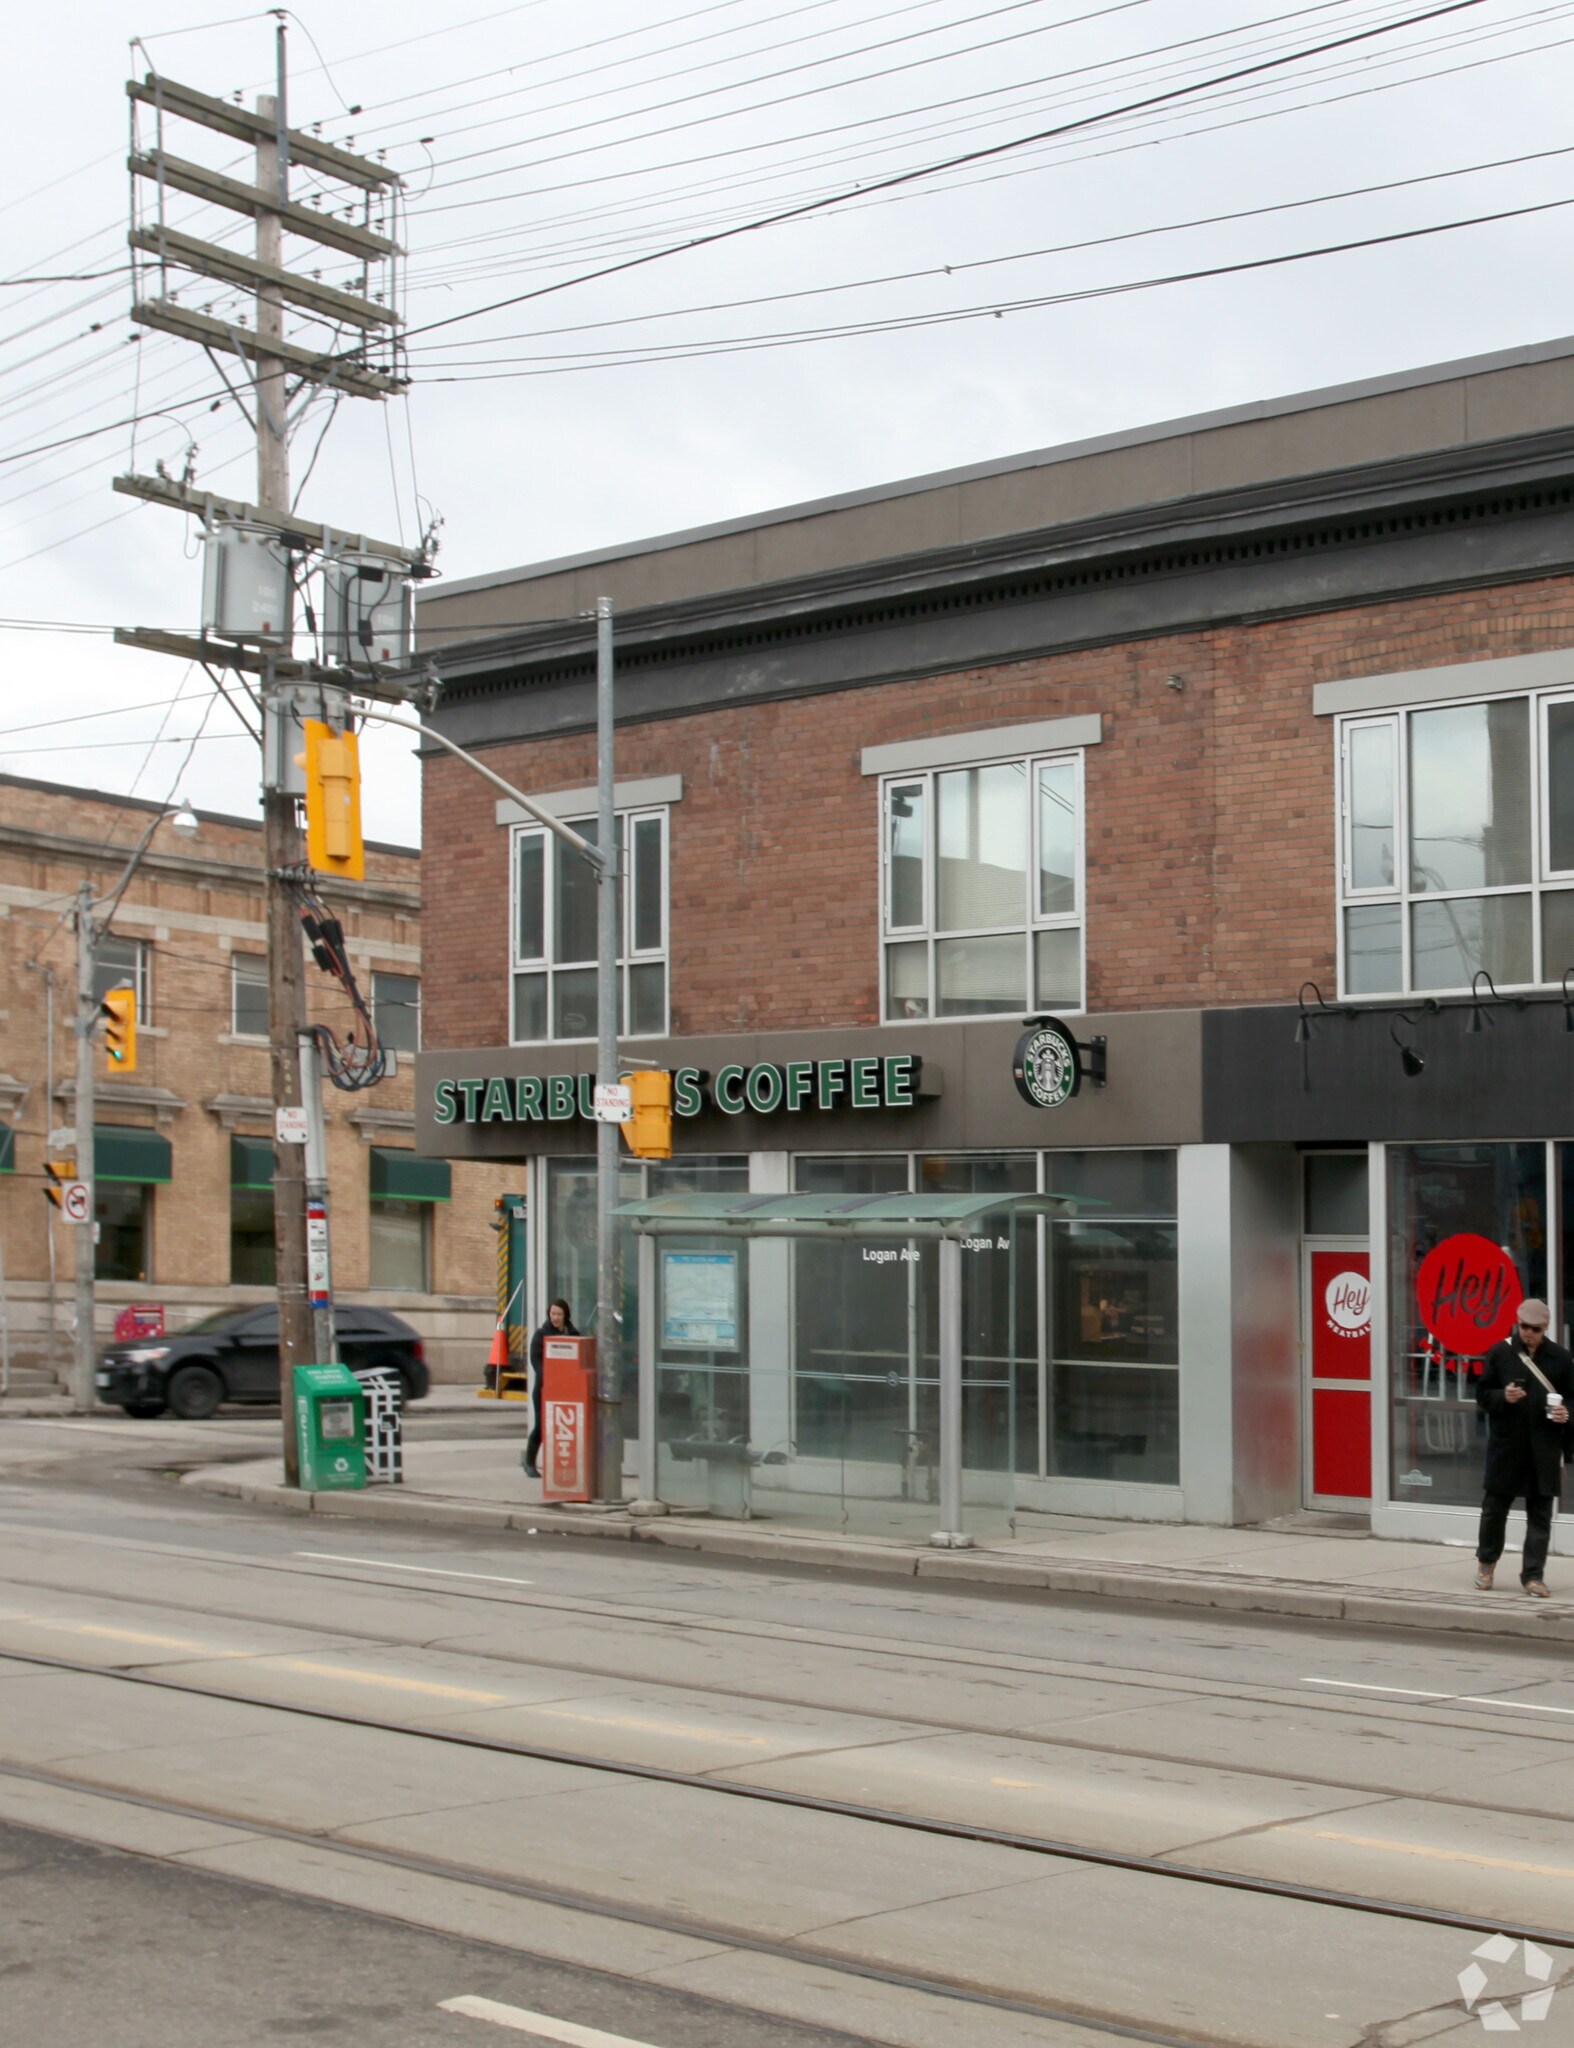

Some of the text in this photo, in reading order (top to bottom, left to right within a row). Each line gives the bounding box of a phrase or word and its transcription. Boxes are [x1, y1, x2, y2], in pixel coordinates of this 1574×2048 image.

[1026, 1033, 1071, 1067] STARBUCKS
[434, 1055, 913, 1124] STARBUS COFFEE
[607, 1087, 619, 1097] NO
[1031, 1082, 1066, 1103] COFFEE
[595, 1097, 630, 1108] STANDING
[960, 1236, 1010, 1251] Logan Av
[863, 1248, 920, 1264] Logan Ave
[1333, 1282, 1371, 1315] Hey
[1431, 1257, 1511, 1328] Hey
[1326, 1319, 1371, 1338] MEATBAL
